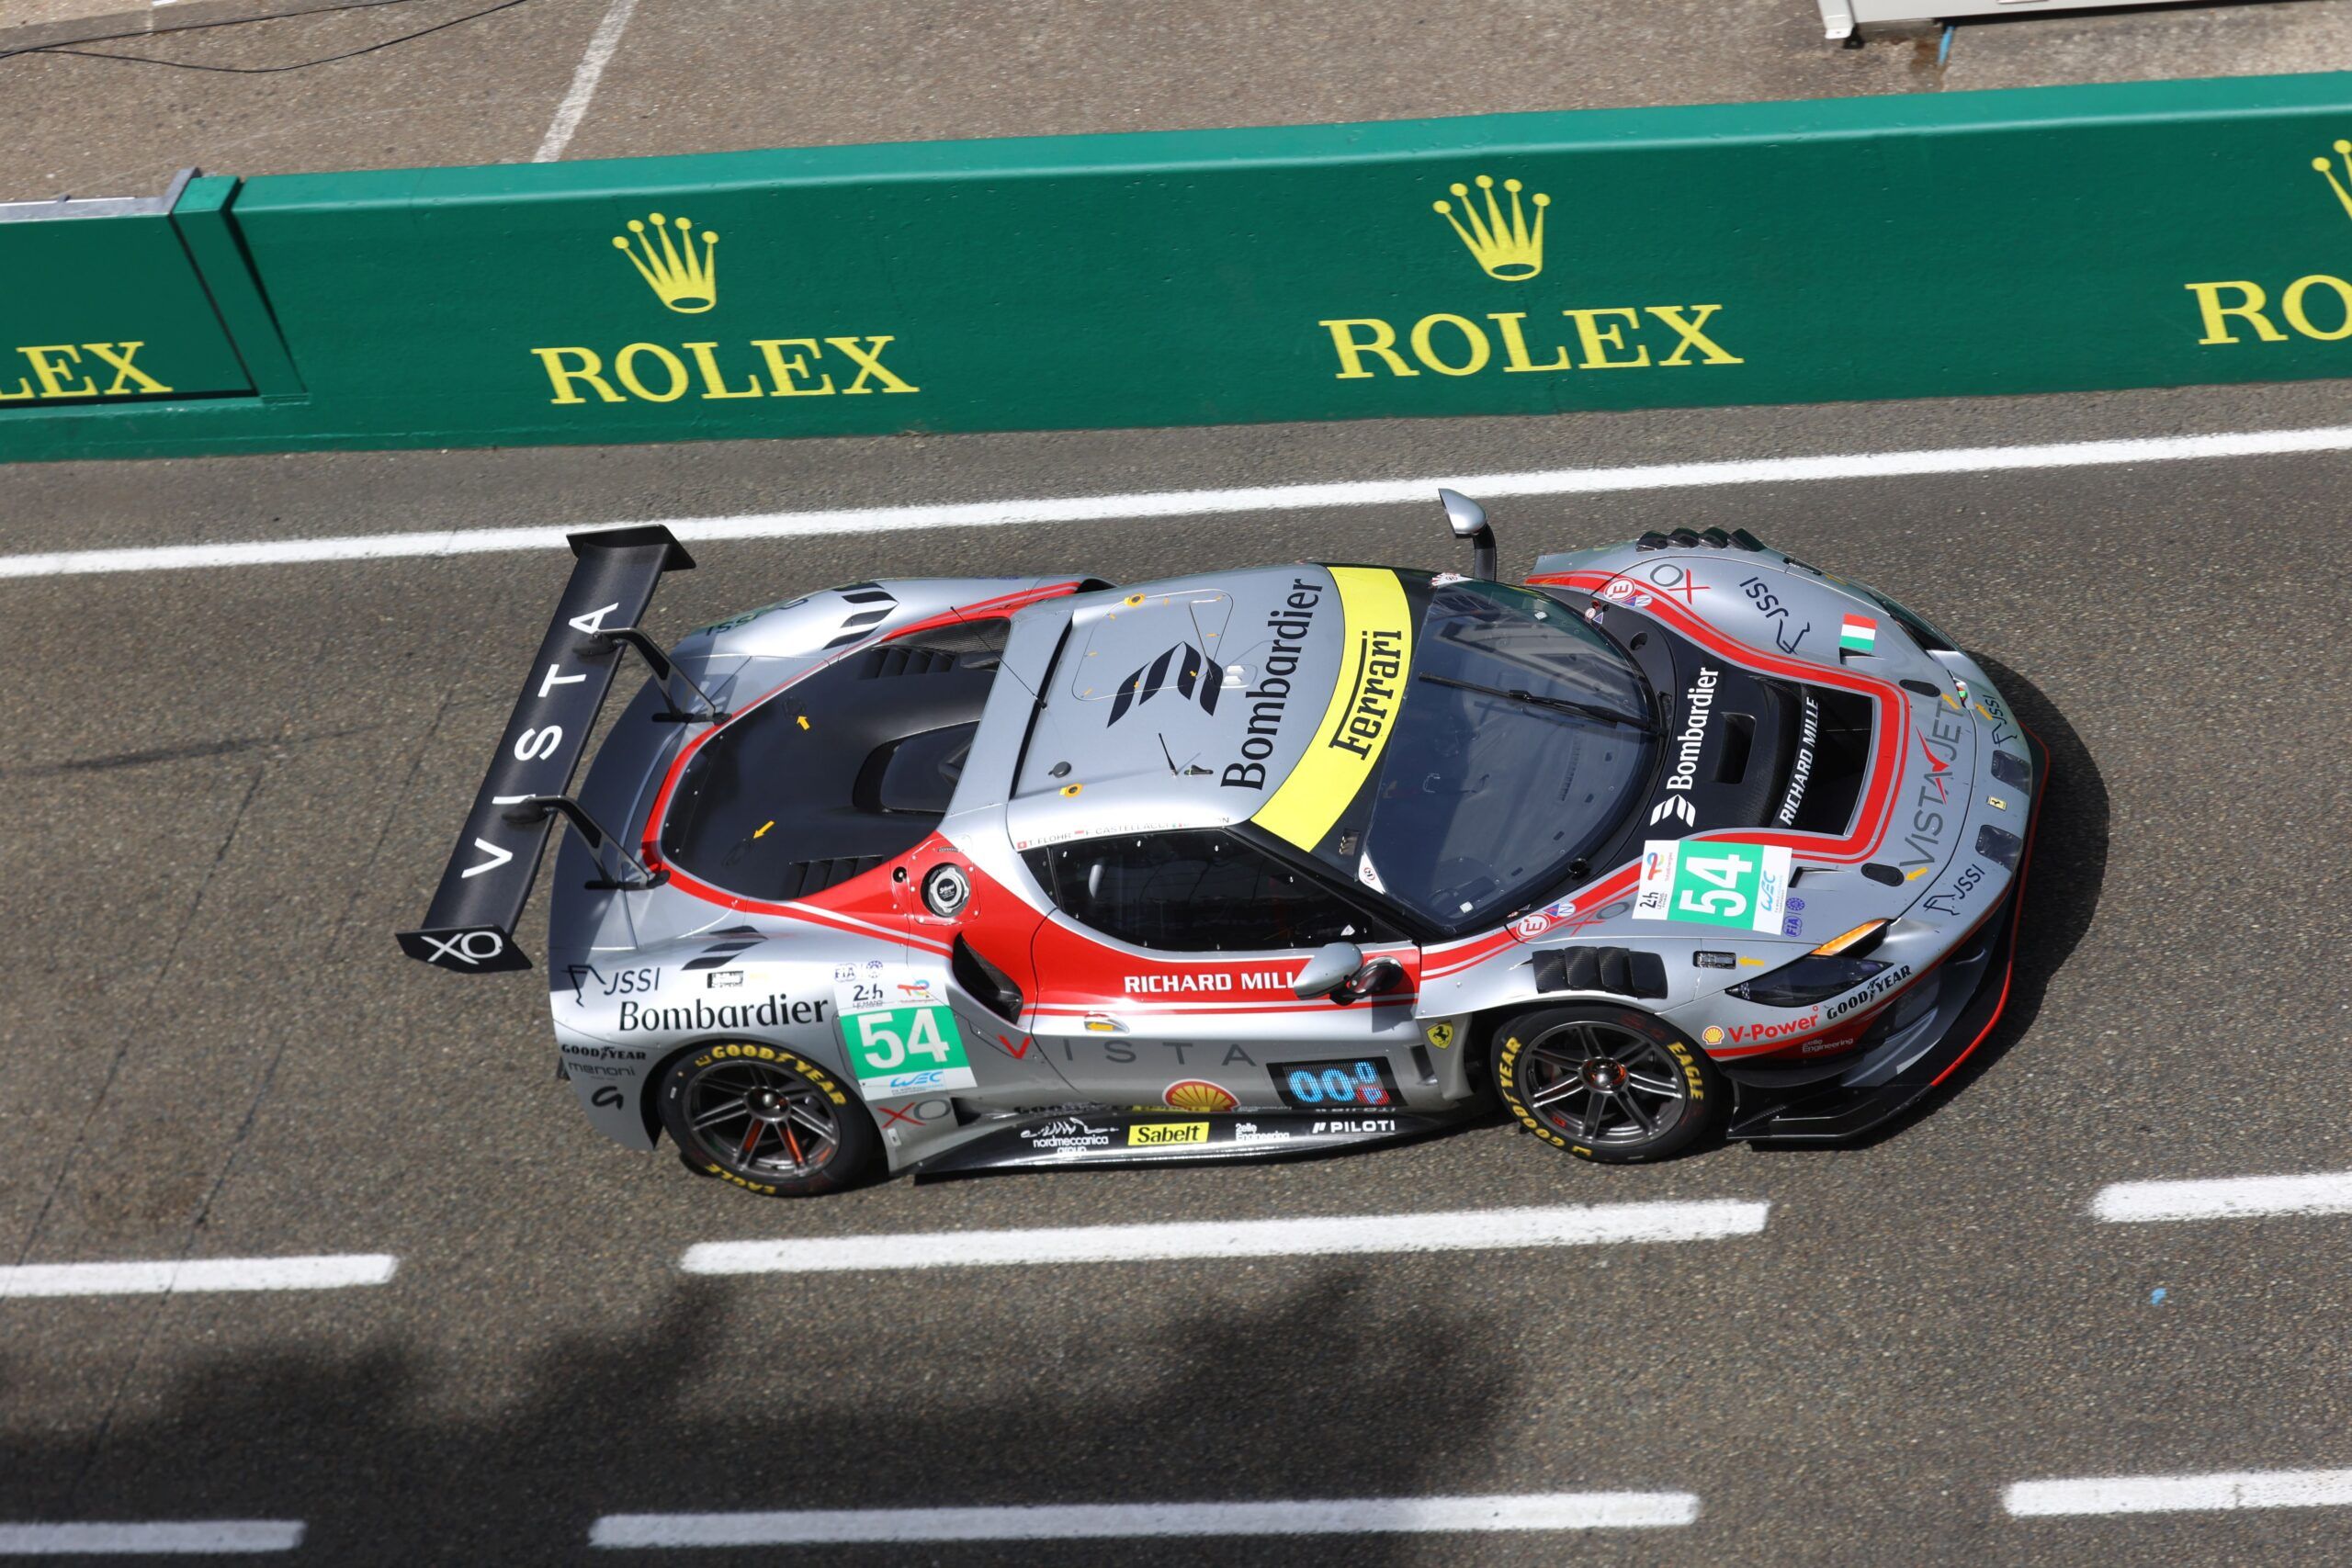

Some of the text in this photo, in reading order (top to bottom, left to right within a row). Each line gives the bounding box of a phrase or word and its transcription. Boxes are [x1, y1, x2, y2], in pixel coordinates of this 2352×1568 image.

[1318, 305, 1744, 378] ROLEX
[532, 336, 919, 404] ROLEX
[1739, 576, 1789, 618] JSSI
[1220, 578, 1324, 790] Bombardier
[1329, 629, 1402, 761] Ferrari
[1666, 667, 1719, 790] Bombardier
[1983, 694, 2007, 725] JSSI
[461, 603, 618, 878] VISTA
[1780, 696, 1818, 826] RICHARD MILLE
[1679, 853, 1753, 917] 54
[1760, 870, 1776, 911] WEC
[1954, 863, 1985, 900] JSSI
[421, 931, 503, 964] XO
[605, 967, 661, 995] JSSI
[1124, 972, 1294, 994] RICHARD MILL
[1826, 964, 1913, 1021] GOODYEAR
[618, 993, 828, 1032] Bombardier
[1728, 1014, 1819, 1043] V-Power
[560, 1043, 647, 1061] GOODYEAR
[856, 1008, 951, 1069] 54
[998, 1034, 1257, 1066] VISTA
[1802, 1038, 1854, 1053] Engineering
[711, 1043, 847, 1105] GOODYEAR
[890, 1070, 944, 1088] WEC
[1667, 1041, 1704, 1100] EAGLE
[1499, 1037, 1566, 1146] GOODYEAR
[876, 1099, 952, 1129] XO
[1137, 1125, 1201, 1143] Sabelt
[1330, 1120, 1396, 1134] PILOTI
[1033, 1135, 1109, 1148] nordmeccanica
